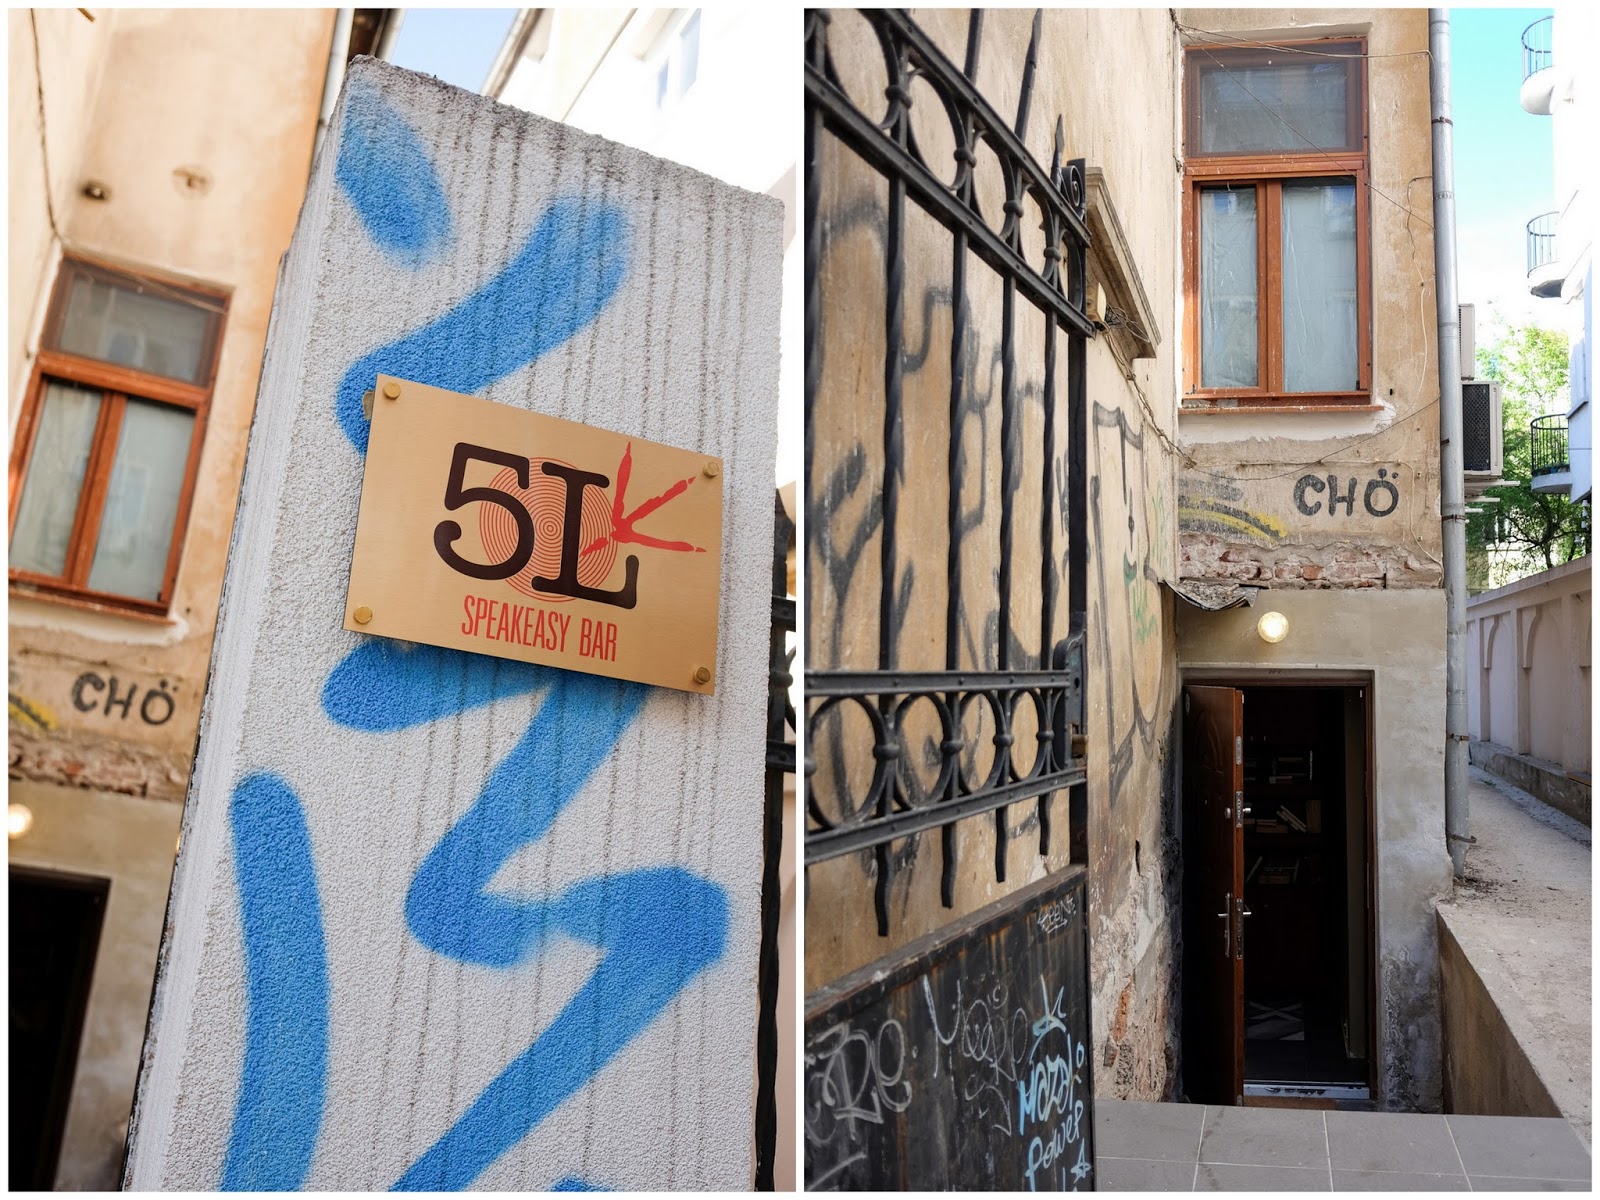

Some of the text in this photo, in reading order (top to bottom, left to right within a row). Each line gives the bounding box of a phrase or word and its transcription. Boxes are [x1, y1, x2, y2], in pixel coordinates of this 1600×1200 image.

[1293, 467, 1399, 518] CHÖ
[461, 594, 618, 662] SPEAKEASY BAR
[72, 671, 179, 725] CHÖ
